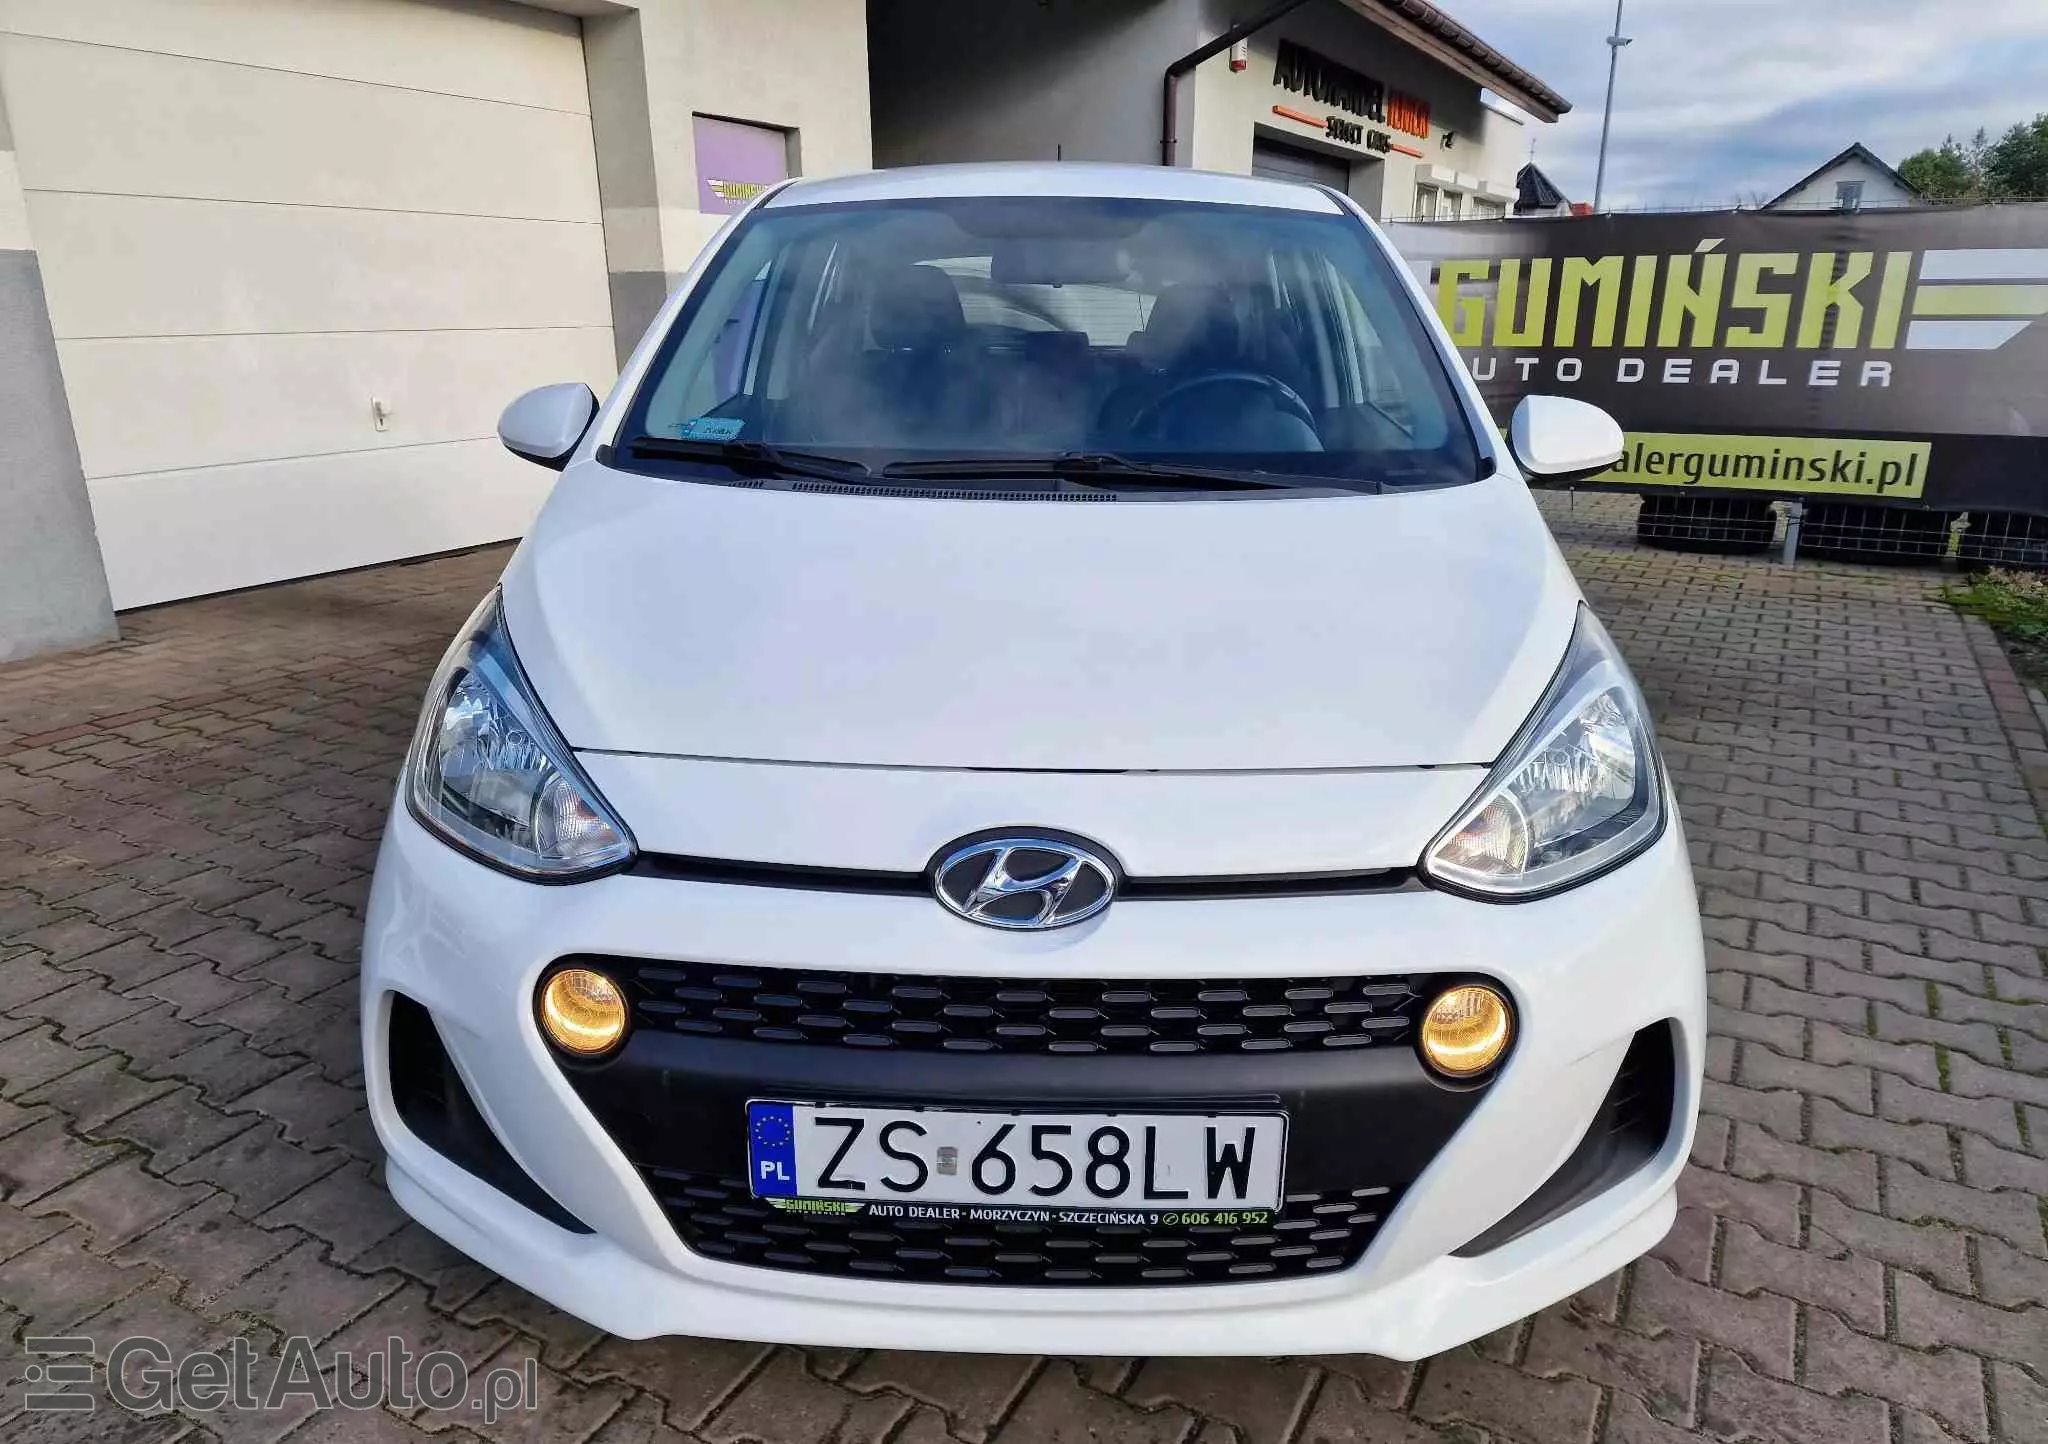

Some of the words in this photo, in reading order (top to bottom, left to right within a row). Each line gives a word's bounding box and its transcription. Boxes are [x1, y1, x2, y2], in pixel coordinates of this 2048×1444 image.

[1437, 238, 1913, 349] GUMIŃSKI
[1471, 356, 1583, 383] UTO
[1616, 357, 1893, 388] DEALER
[1611, 442, 1919, 494] alerguminski.pl
[760, 1160, 790, 1182] PL
[814, 1116, 929, 1193] ZS
[970, 1123, 1256, 1200] 658LW
[868, 1204, 904, 1217] AUTO
[969, 1208, 1050, 1221] MORZYCZYN
[1058, 1211, 1146, 1225] SZCZECIŃSKA
[1150, 1213, 1159, 1225] 9
[1181, 1212, 1210, 1225] 606
[1213, 1212, 1238, 1224] 416
[1241, 1211, 1268, 1224] 952
